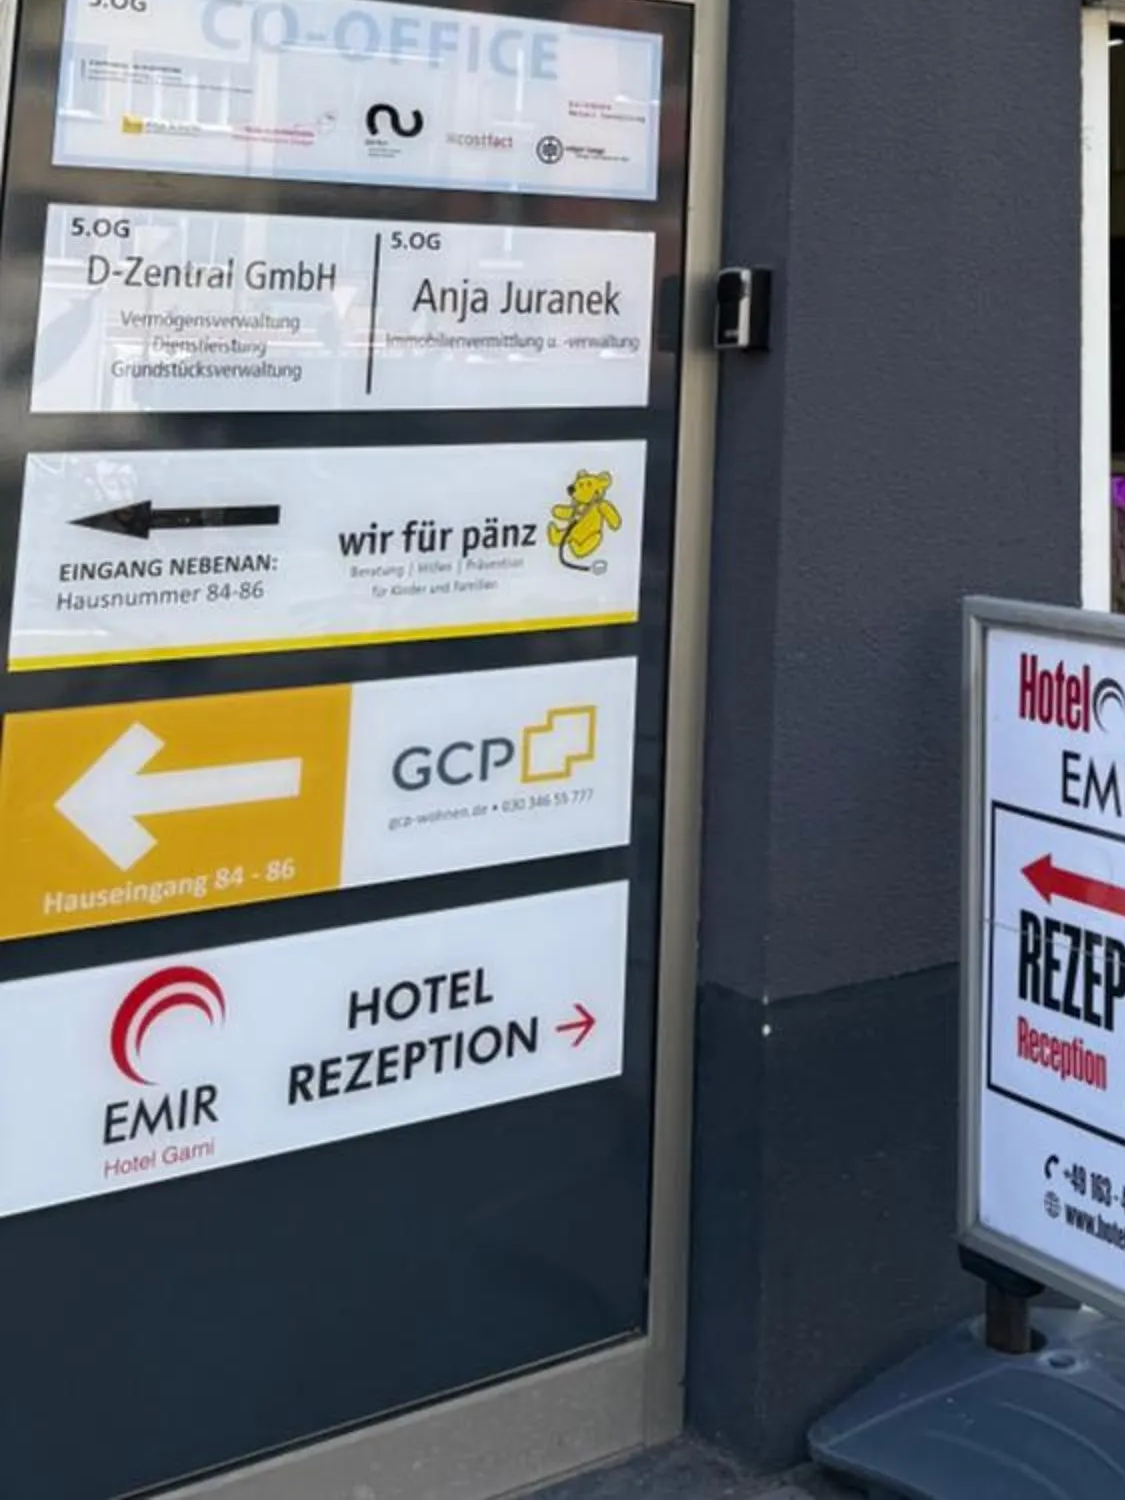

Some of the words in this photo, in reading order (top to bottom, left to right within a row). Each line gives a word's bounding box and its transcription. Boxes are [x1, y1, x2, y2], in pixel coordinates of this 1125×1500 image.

[70, 217, 131, 239] 5.OG
[390, 231, 442, 251] 5.OG
[87, 254, 235, 290] D-Zentral
[245, 260, 337, 292] GmbH
[120, 310, 301, 332] Vermögensverwaltung
[412, 278, 489, 323] Anja
[500, 281, 621, 316] Juranek
[111, 360, 302, 382] Grundstücksverwaltung
[338, 522, 394, 557] wir
[401, 519, 453, 554] für
[462, 517, 538, 559] pänz
[59, 558, 163, 582] EINGANG
[169, 553, 279, 577] NEBENAN:
[56, 586, 200, 611] Hausnummer
[206, 580, 265, 602] 84-86
[1019, 652, 1091, 734] Hotel
[392, 736, 516, 792] GCP
[43, 874, 208, 915] Hauseingang
[214, 865, 244, 889] 84
[265, 857, 296, 882] 86
[347, 967, 494, 1031] HOTEL
[287, 1016, 540, 1106] REZEPTION
[1017, 1015, 1108, 1092] Reception
[104, 1083, 219, 1145] EMIR
[104, 1149, 156, 1178] Hotel
[161, 1136, 215, 1165] Garni
